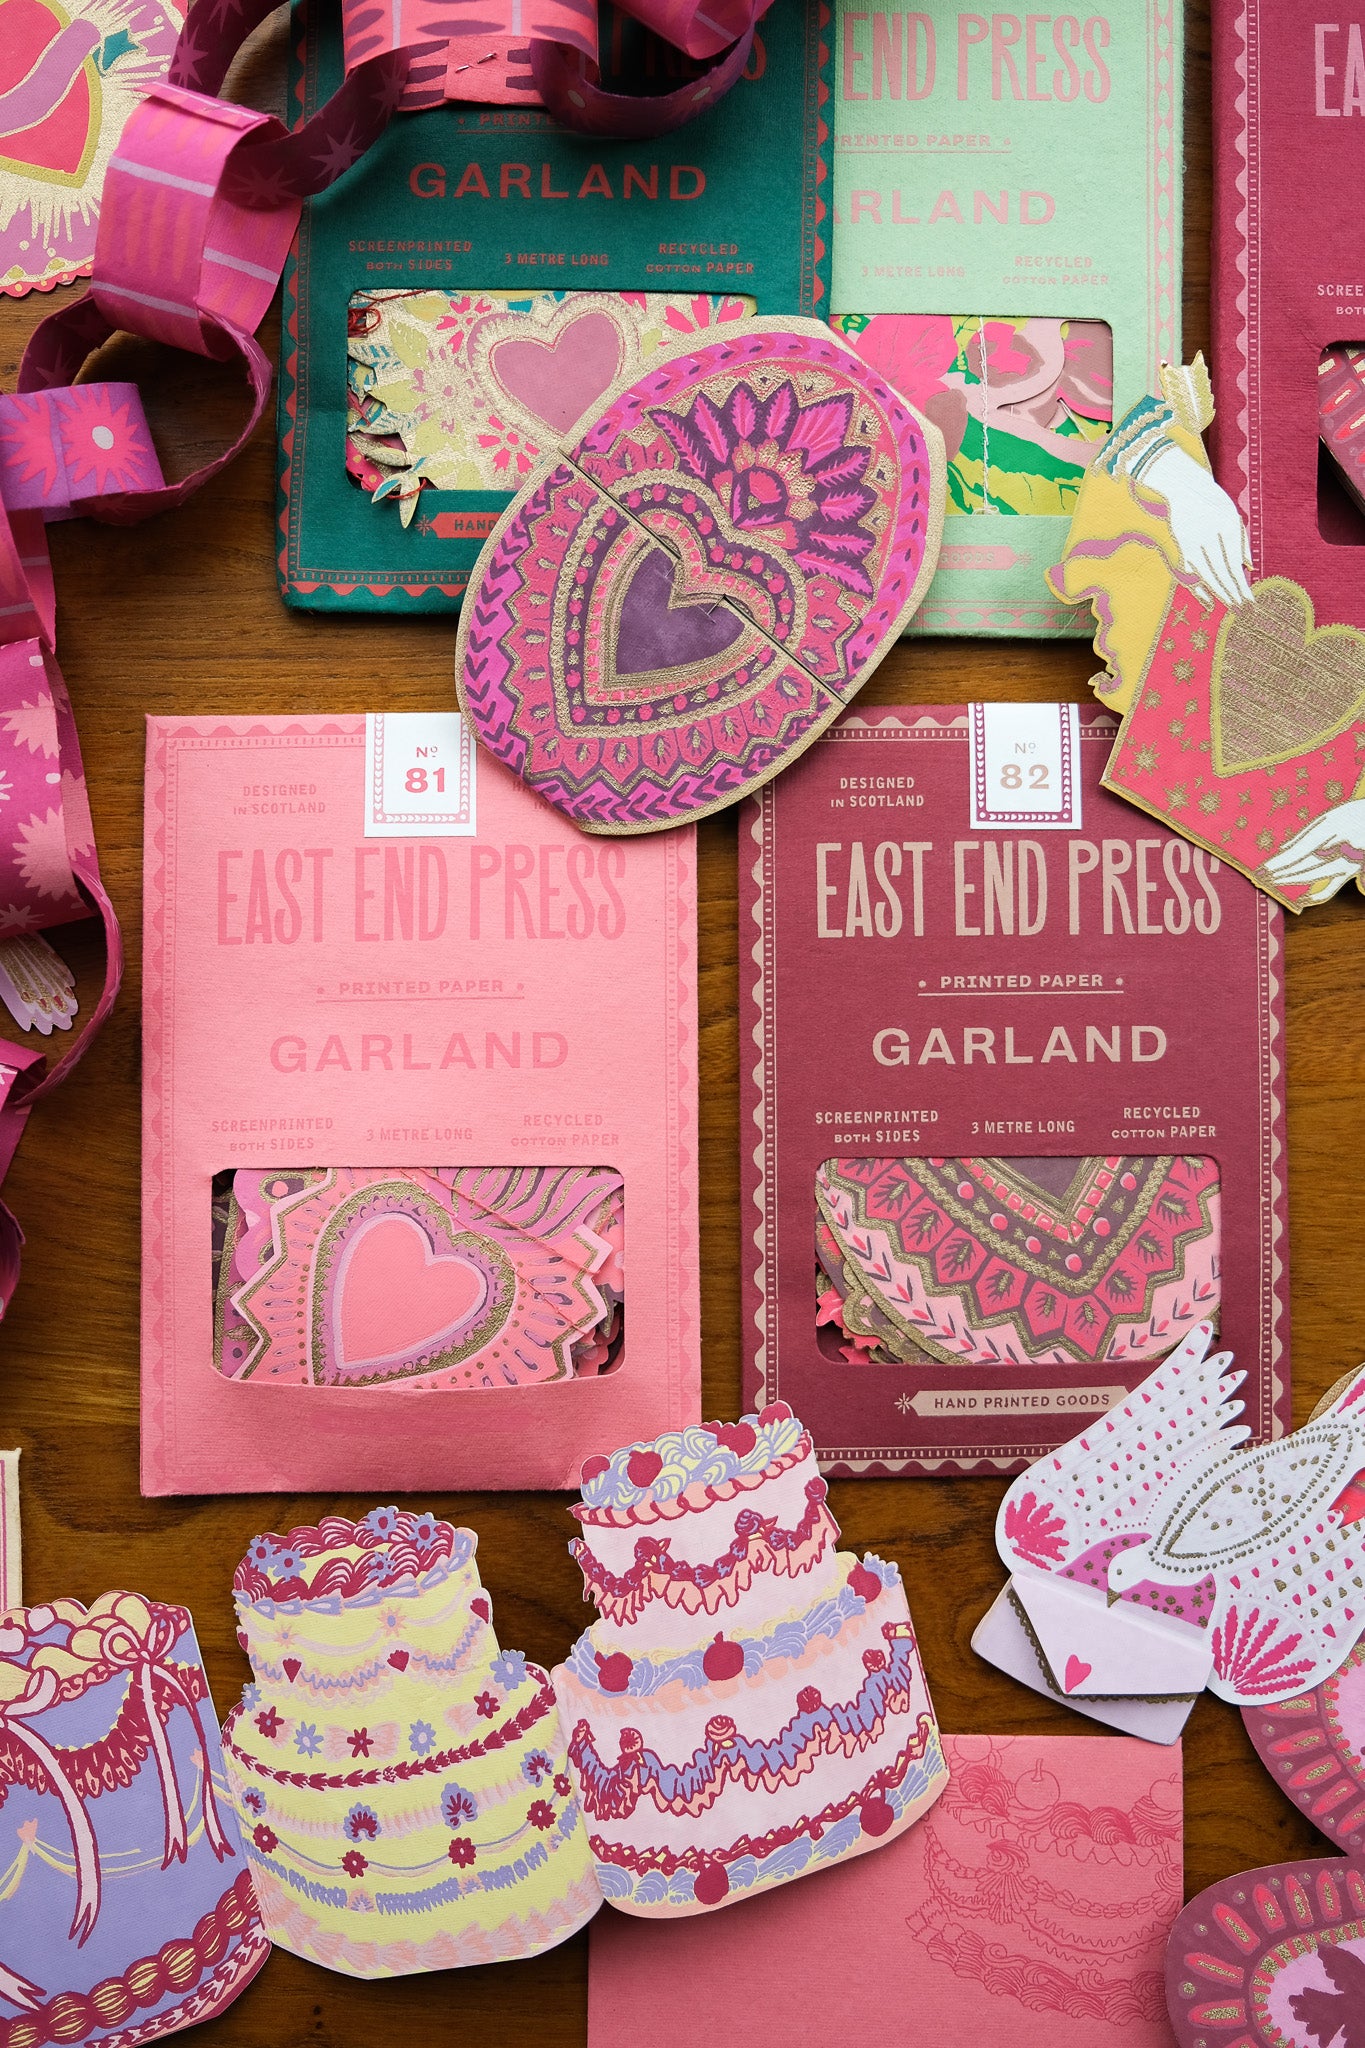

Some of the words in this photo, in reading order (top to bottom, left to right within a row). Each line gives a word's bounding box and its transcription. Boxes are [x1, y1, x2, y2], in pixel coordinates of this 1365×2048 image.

[843, 12, 936, 100] END
[957, 13, 1112, 103] PRESS
[926, 134, 991, 147] PAPER
[408, 162, 707, 200] GARLAND
[348, 240, 472, 254] SCREENPRINTED
[658, 243, 738, 255] RECYCLED
[366, 261, 403, 270] BOTH
[408, 259, 453, 271] SIDES
[504, 253, 513, 265] 3
[517, 254, 566, 266] METRE
[571, 254, 609, 266] LONG
[1014, 256, 1093, 268] RECYCLED
[646, 264, 700, 274] COTTON
[706, 262, 755, 275] PAPER
[861, 266, 869, 277] 3
[874, 266, 922, 277] METRE
[928, 266, 966, 277] LONG
[1002, 276, 1056, 285] COTTON
[1062, 275, 1110, 285] PAPER
[1336, 306, 1365, 315] BOT
[940, 551, 995, 563] GOODS
[405, 767, 445, 794] 81
[839, 776, 915, 790] DESIGNED
[1000, 764, 1050, 790] 82
[243, 784, 317, 796] DESIGNED
[830, 798, 846, 808] IN
[849, 794, 925, 808] SCOTLAND
[233, 805, 247, 816] IN
[252, 802, 326, 815] SCOTLAND
[217, 847, 334, 945] EAST
[354, 845, 449, 942] END
[469, 843, 627, 940] PRESS
[816, 841, 933, 939] EAST
[954, 839, 1048, 936] END
[1068, 838, 1222, 936] PRESS
[338, 981, 431, 995] PRINTED
[439, 979, 504, 993] PAPER
[940, 974, 1032, 989] PRINTED
[1040, 973, 1104, 988] PAPER
[269, 1031, 570, 1073] GARLAND
[871, 1024, 1168, 1067] GARLAND
[814, 1109, 939, 1125] SCREENPRINTED
[1123, 1106, 1201, 1120] RECYCLED
[211, 1118, 334, 1132] SCREENPRINTED
[523, 1114, 603, 1127] RECYCLED
[971, 1121, 980, 1135] 3
[984, 1121, 1033, 1135] METRE
[1037, 1120, 1076, 1134] LONG
[366, 1130, 375, 1142] 3
[379, 1129, 430, 1142] METRE
[434, 1128, 473, 1141] LONG
[833, 1132, 871, 1144] BOTH
[875, 1128, 921, 1144] SIDES
[1111, 1128, 1166, 1140] COTTON
[1170, 1125, 1217, 1138] PAPER
[229, 1141, 266, 1153] BOTH
[269, 1137, 315, 1151] SIDES
[510, 1135, 567, 1147] COTTON
[571, 1133, 621, 1146] PAPER
[934, 1397, 977, 1409] HAND
[983, 1396, 1051, 1408] PRINTED
[1056, 1394, 1110, 1406] GOODS
